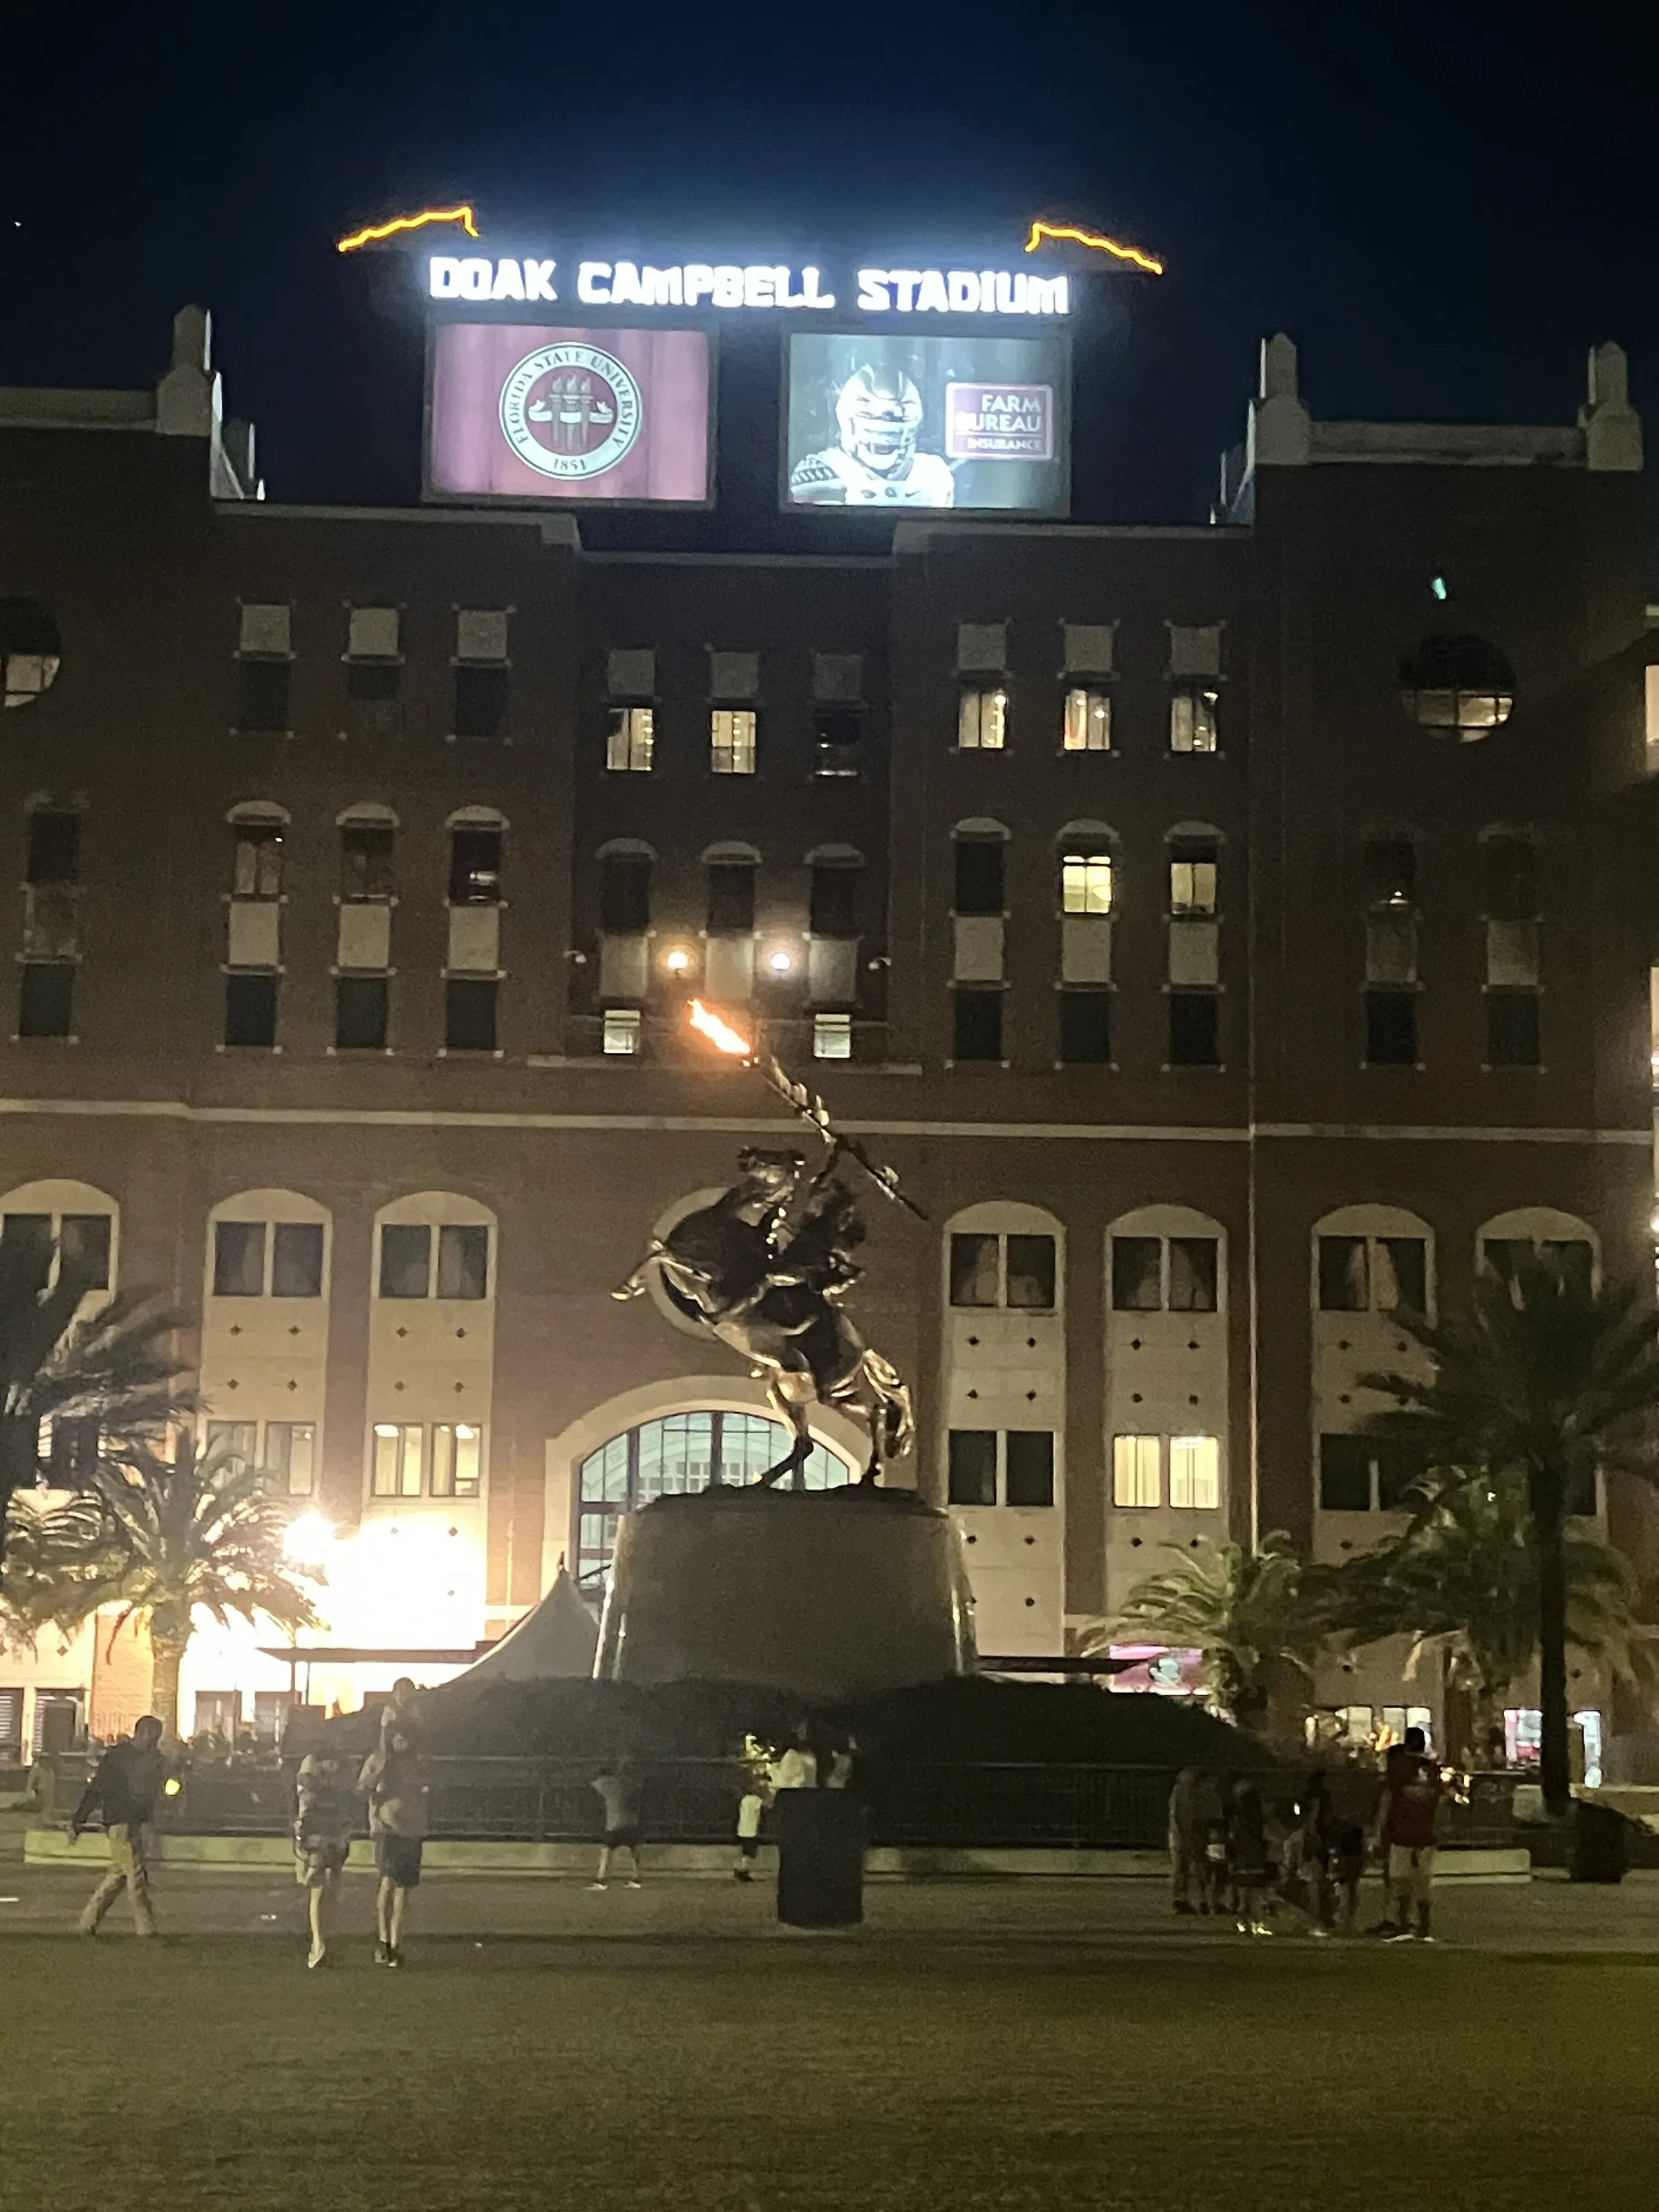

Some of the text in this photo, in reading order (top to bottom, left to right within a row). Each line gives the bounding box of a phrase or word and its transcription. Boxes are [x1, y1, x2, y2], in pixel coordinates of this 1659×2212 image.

[429, 256, 1071, 314] DOAK CAMPBELL STADIUM
[508, 351, 634, 449] FLORIDA STATE UNIVERSITY
[982, 394, 1041, 413] FARM
[955, 411, 1041, 432] UREAU
[553, 458, 586, 471] 1851
